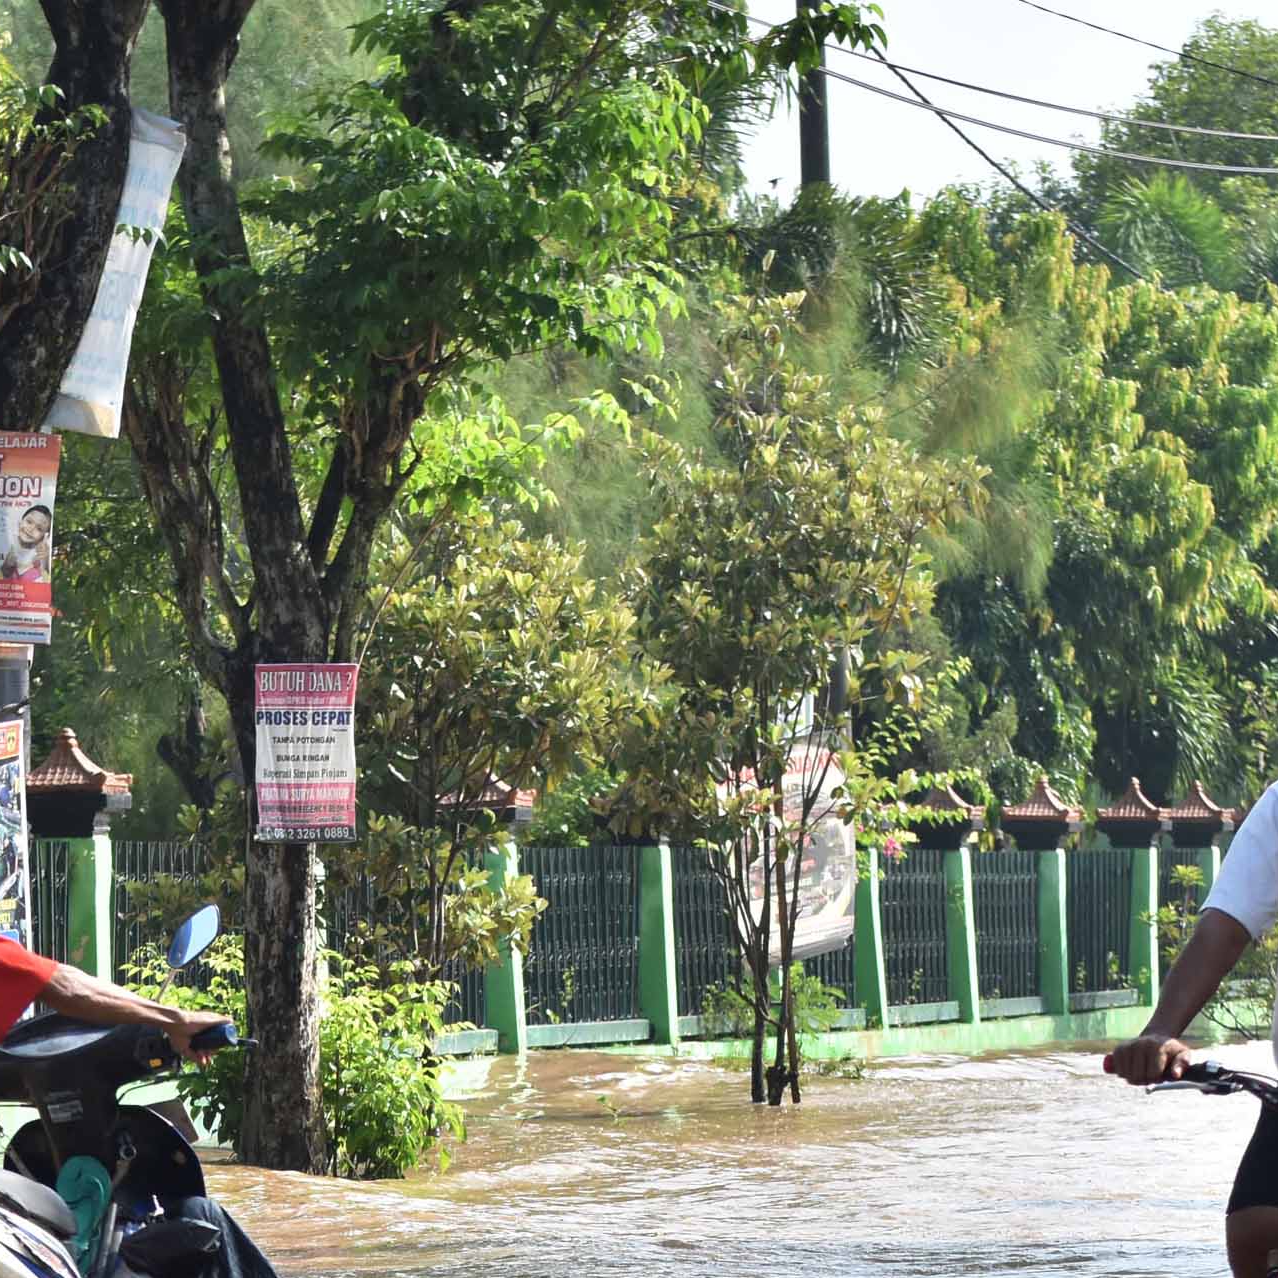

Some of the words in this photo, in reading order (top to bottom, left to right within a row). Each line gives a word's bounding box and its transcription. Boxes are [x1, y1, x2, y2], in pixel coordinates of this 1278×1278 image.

[259, 671, 305, 693] BUTUH
[308, 671, 341, 693] DANA
[256, 711, 308, 726] PROSES
[311, 711, 353, 726] CEPAT
[272, 736, 295, 744] TANPA
[296, 736, 336, 744] POTONGAN
[276, 754, 300, 762] BUNGA
[302, 754, 330, 762] RINGAN
[293, 768, 320, 781] Simpan
[297, 828, 321, 840] 3261
[324, 827, 349, 839] 0889
